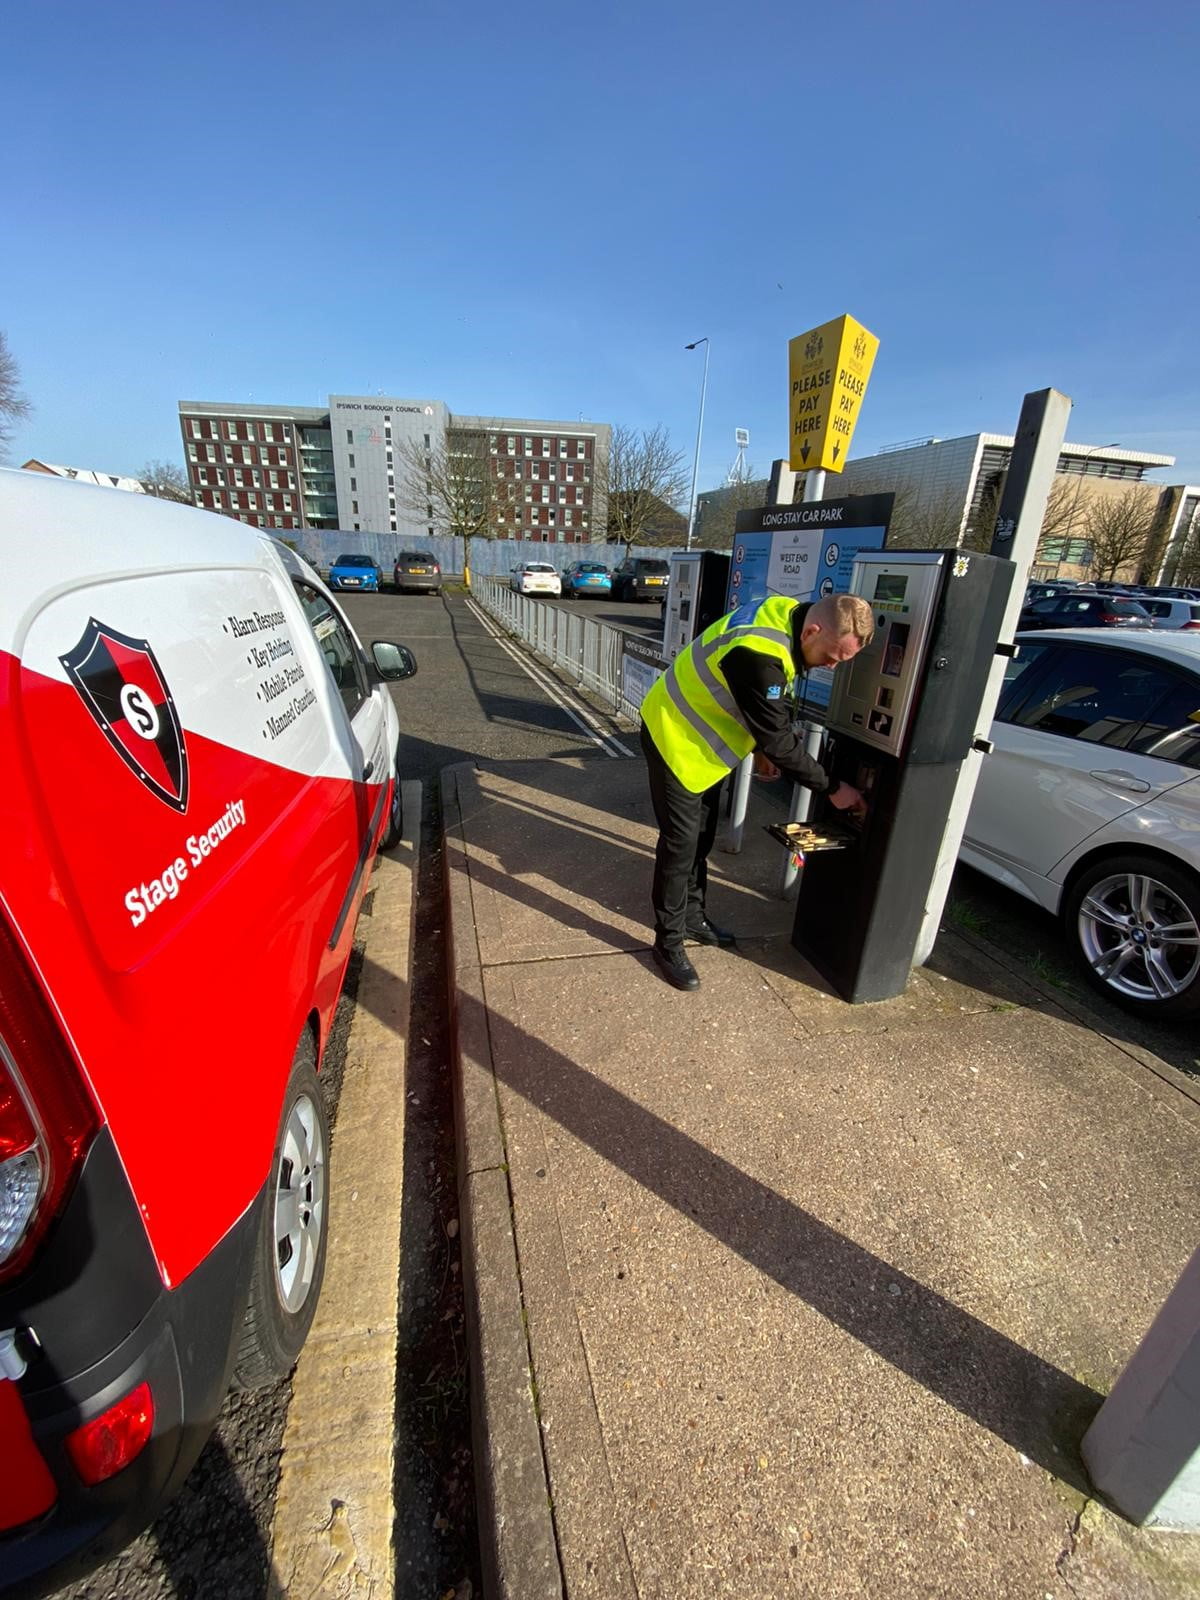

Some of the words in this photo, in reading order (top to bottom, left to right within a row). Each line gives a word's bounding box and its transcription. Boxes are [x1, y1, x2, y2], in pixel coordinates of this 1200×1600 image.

[793, 369, 831, 396] PLEASE
[839, 370, 864, 397] PLEASE
[799, 394, 820, 414] PAY
[839, 395, 854, 414] PAY
[794, 415, 821, 435] HERE
[832, 416, 851, 436] HERE
[762, 513, 783, 526] LONG
[783, 511, 802, 524] STAY
[802, 509, 819, 522] CAR
[820, 507, 843, 521] PARK
[779, 553, 797, 563] WEST
[797, 553, 808, 563] END
[783, 564, 800, 574] ROAD
[228, 616, 258, 638] Alarm
[253, 611, 287, 631] Response
[250, 647, 271, 668] Key
[266, 638, 293, 661] Holding
[260, 674, 287, 703] Mobile
[283, 662, 304, 686] Patrols
[126, 690, 154, 734] S
[266, 702, 296, 740] Manned
[293, 688, 318, 716] Guarding
[124, 857, 188, 928] Stage
[186, 799, 246, 868] Security
